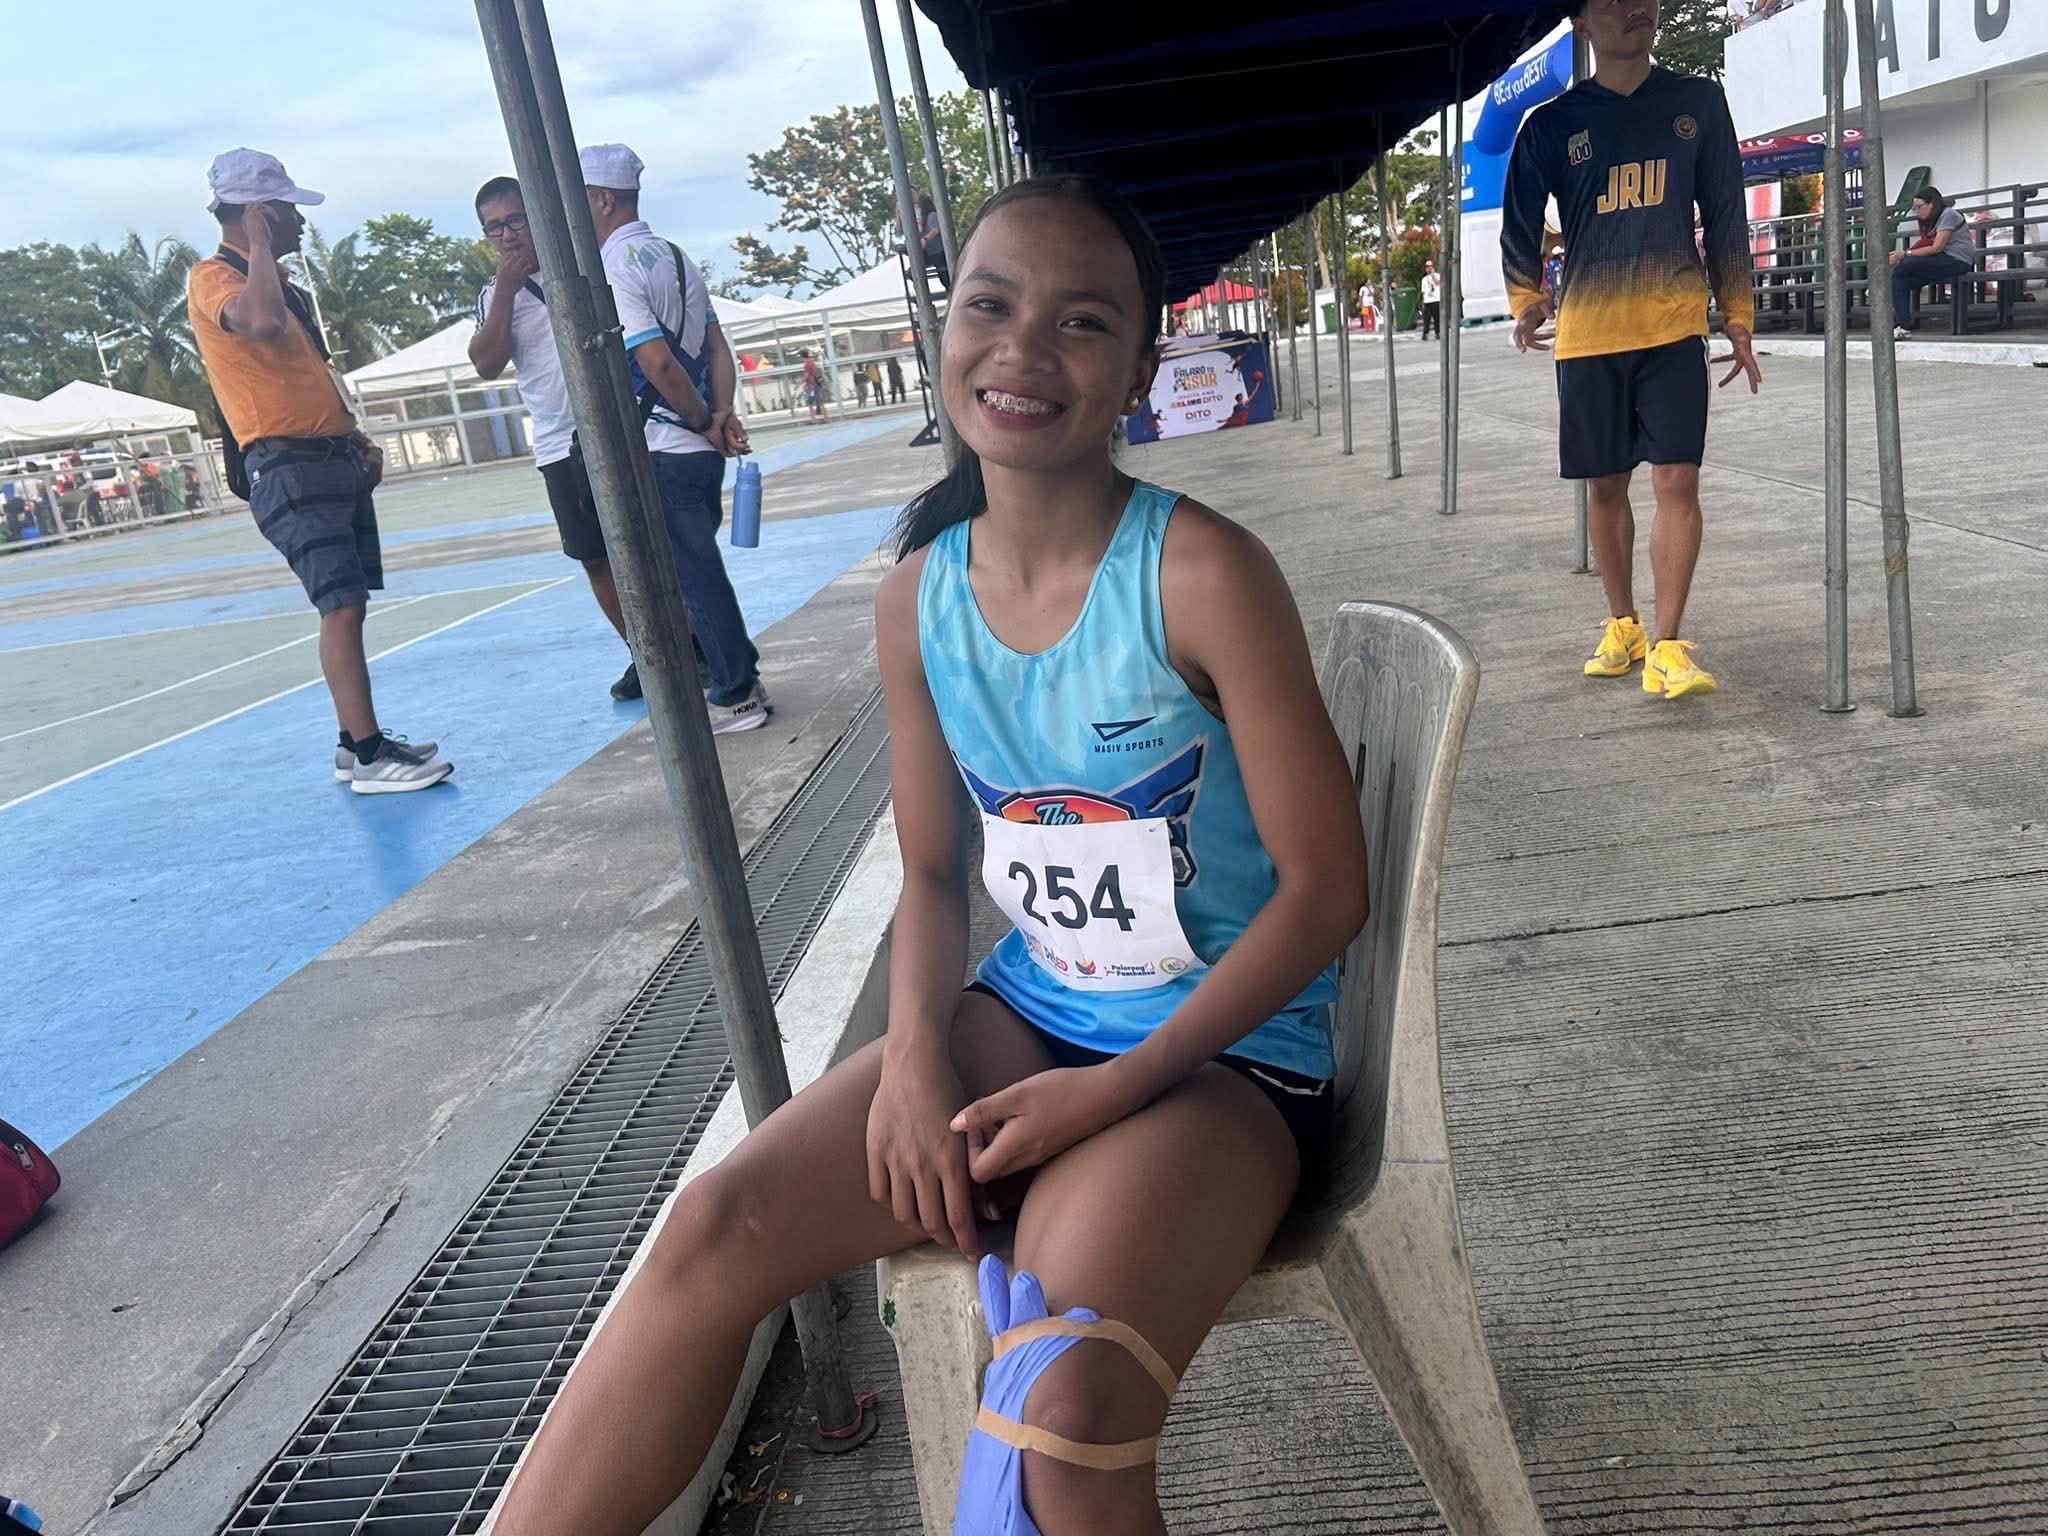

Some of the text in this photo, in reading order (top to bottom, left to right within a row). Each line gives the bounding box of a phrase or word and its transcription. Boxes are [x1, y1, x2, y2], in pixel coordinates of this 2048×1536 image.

[1597, 159, 1666, 214] JRU
[1185, 409, 1212, 420] DITO
[733, 701, 757, 716] HOKA
[1094, 737, 1164, 753] MASIV SPORTS
[1036, 803, 1082, 825] The
[1008, 861, 1136, 932] 254
